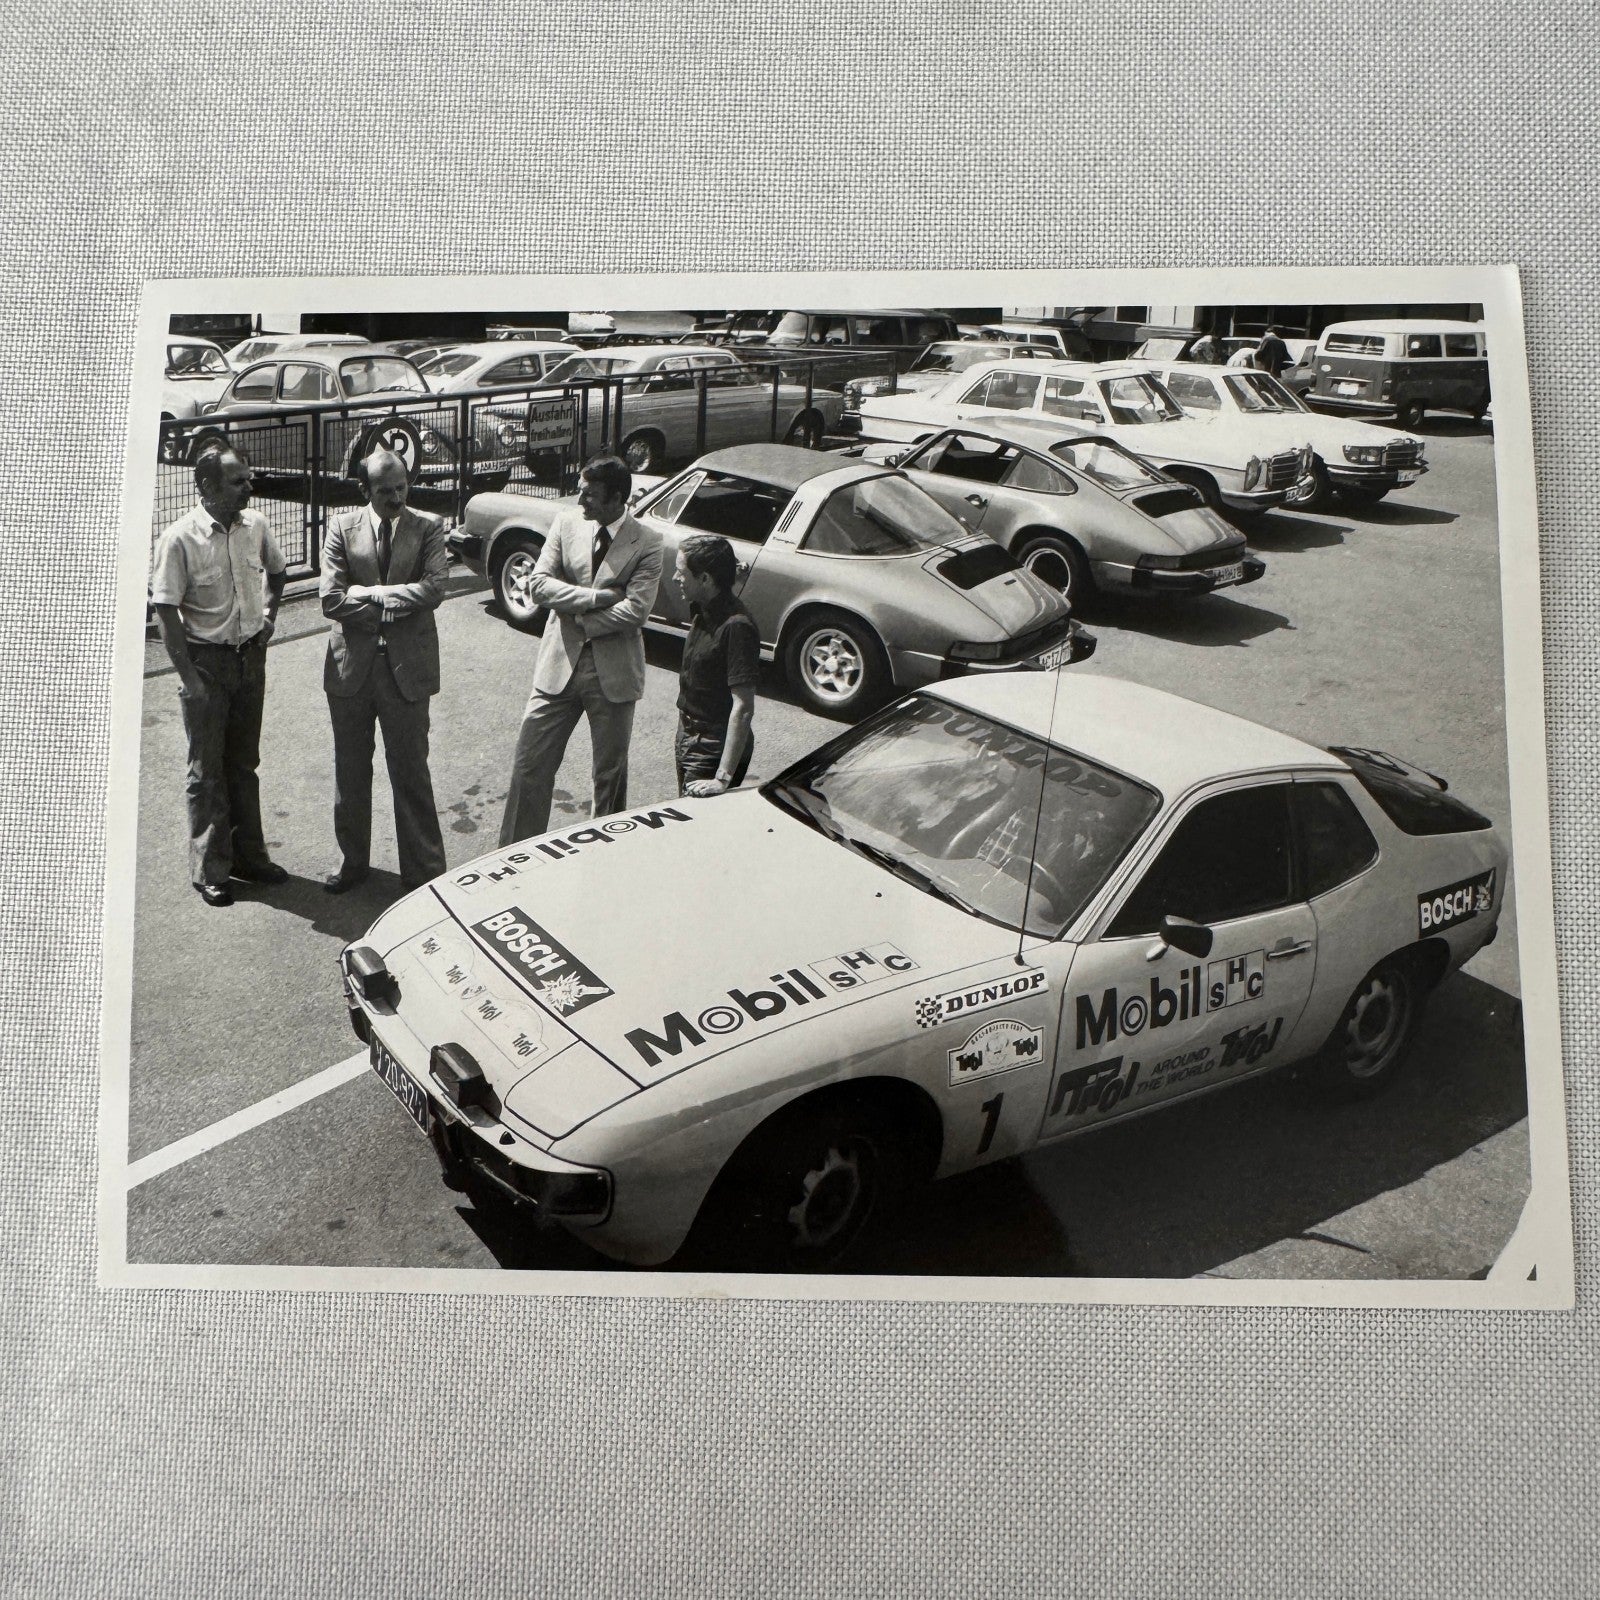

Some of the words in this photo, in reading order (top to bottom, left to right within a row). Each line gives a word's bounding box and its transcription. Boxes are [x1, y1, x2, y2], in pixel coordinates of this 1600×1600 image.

[908, 700, 1123, 798] DUNLOP
[535, 807, 694, 860] Mobil
[1420, 886, 1472, 929] BOSCH
[481, 911, 568, 977] BOSCH
[624, 968, 828, 1067] Mobil
[945, 972, 1046, 1014] DUNLOP
[1076, 965, 1201, 1050] Mobil
[1136, 1075, 1163, 1096] THE
[1166, 1059, 1216, 1085] WORLD
[1151, 1046, 1211, 1077] AROUND
[976, 1092, 1004, 1155] 1
